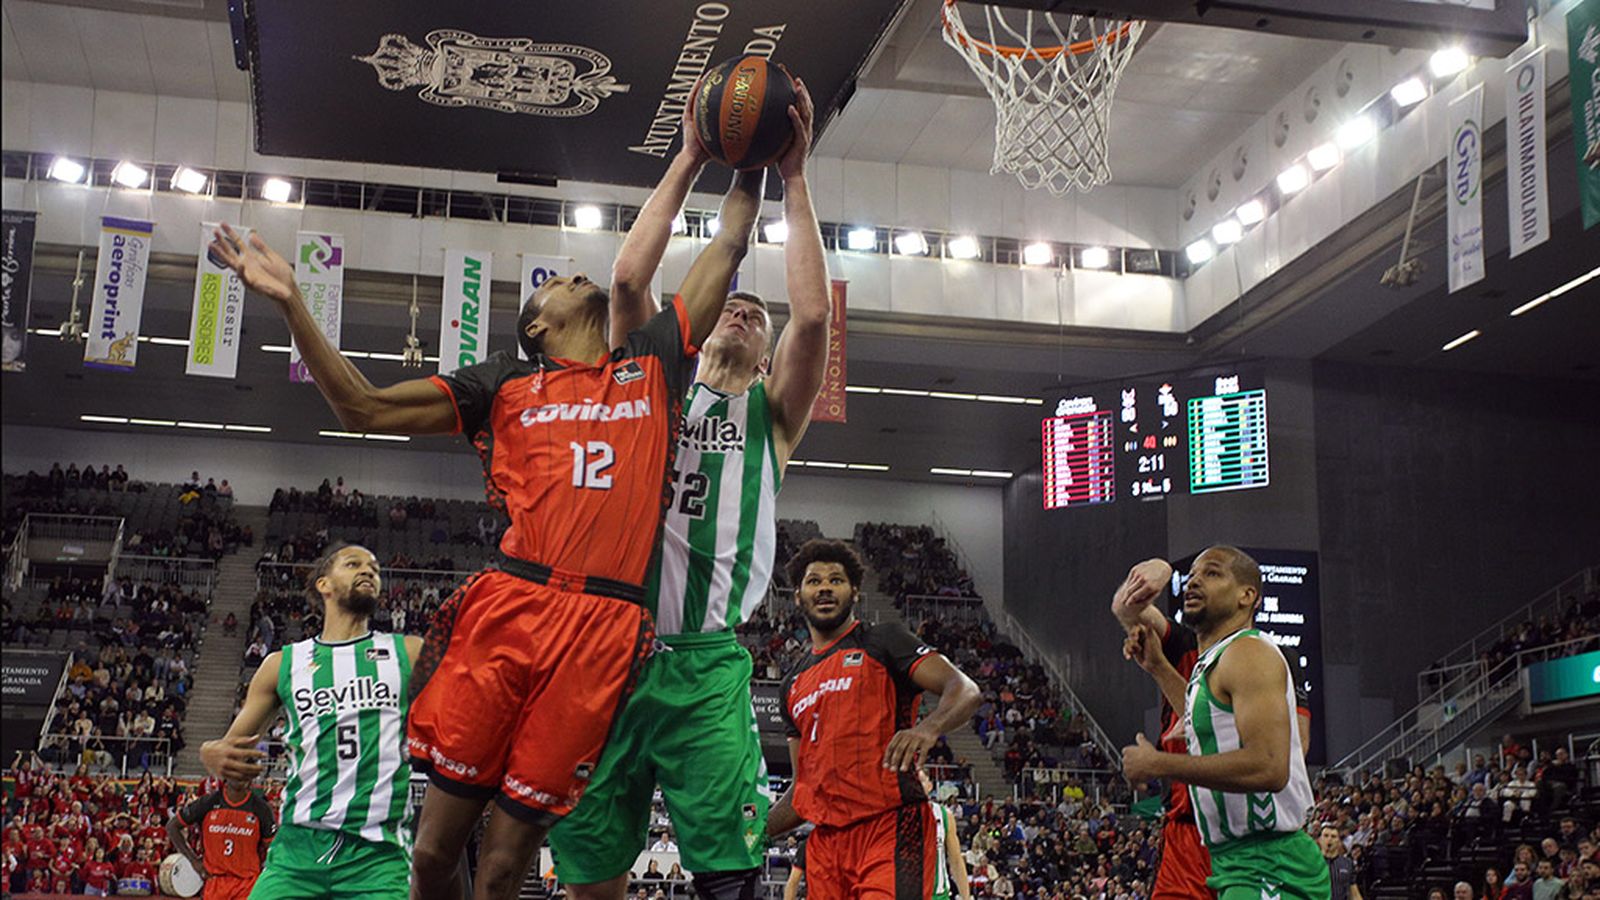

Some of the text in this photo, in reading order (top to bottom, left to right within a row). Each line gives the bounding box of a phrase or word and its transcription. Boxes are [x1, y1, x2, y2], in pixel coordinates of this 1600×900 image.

[628, 2, 730, 158] AYUNTAMIENTO
[102, 234, 126, 340] aeroprint
[313, 283, 326, 328] Palaci
[326, 284, 340, 339] Farmacia
[456, 256, 483, 368] OVIRAN
[193, 273, 214, 366] ASCENSORES
[829, 327, 841, 416] ANTONIO
[520, 396, 651, 427] COVIRAN
[569, 440, 616, 489] 12
[1138, 454, 1165, 473] 2:11
[337, 725, 358, 760] 5
[223, 839, 234, 856] 3
